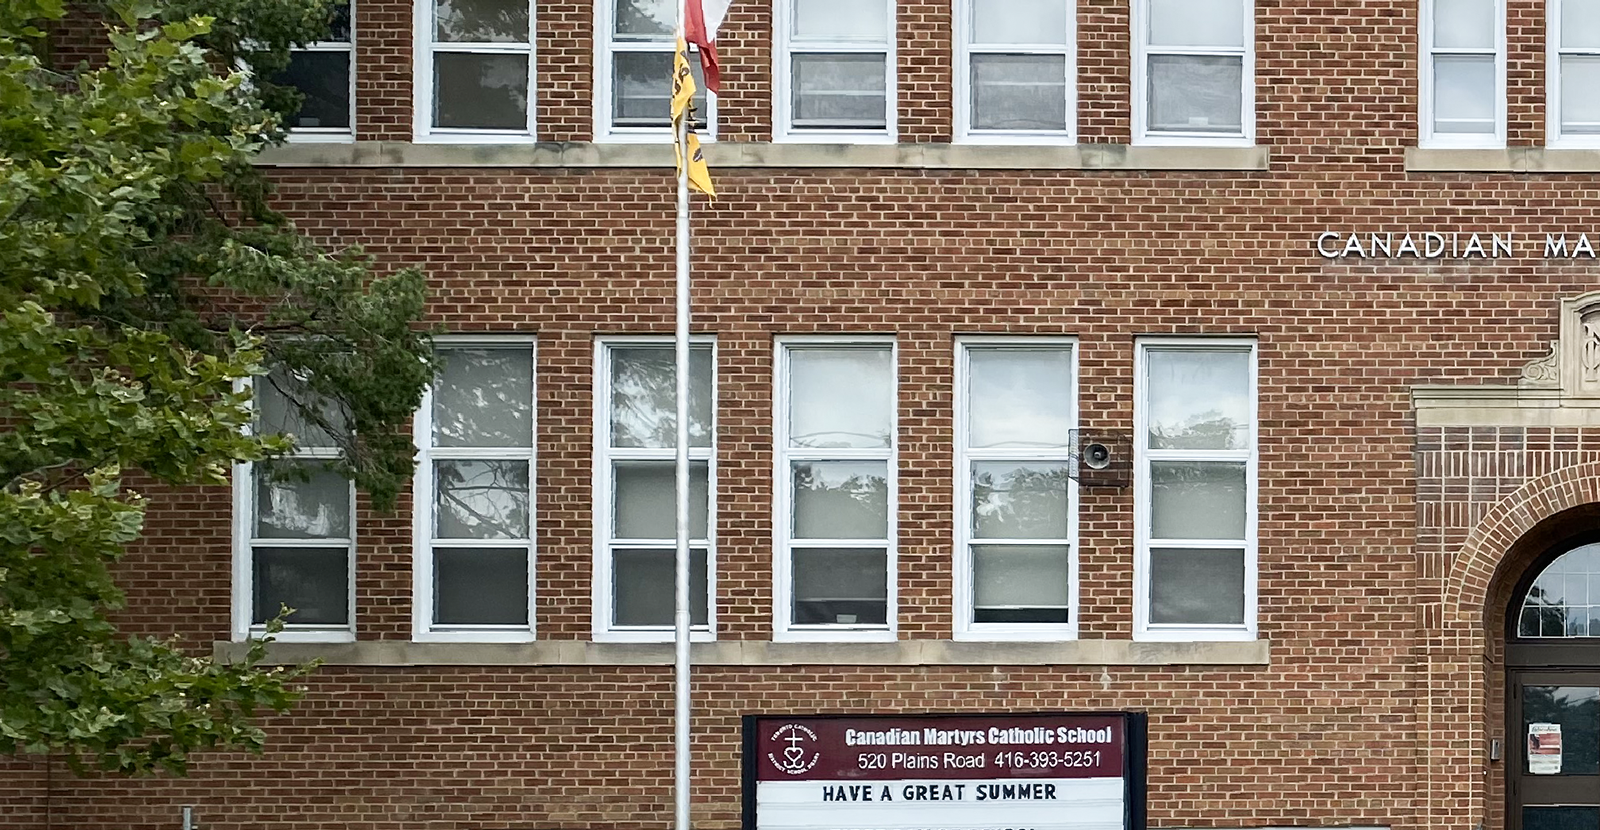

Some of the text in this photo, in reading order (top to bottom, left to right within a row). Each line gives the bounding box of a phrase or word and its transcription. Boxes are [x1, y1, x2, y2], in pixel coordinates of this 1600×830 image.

[1317, 231, 1512, 258] CANADIAN
[845, 726, 1112, 747] Canadian Martyrs Catholic School
[858, 751, 1101, 769] 520 Plains Road 416-393-5251
[823, 783, 1057, 802] HAVE A GREAT SUMMER
